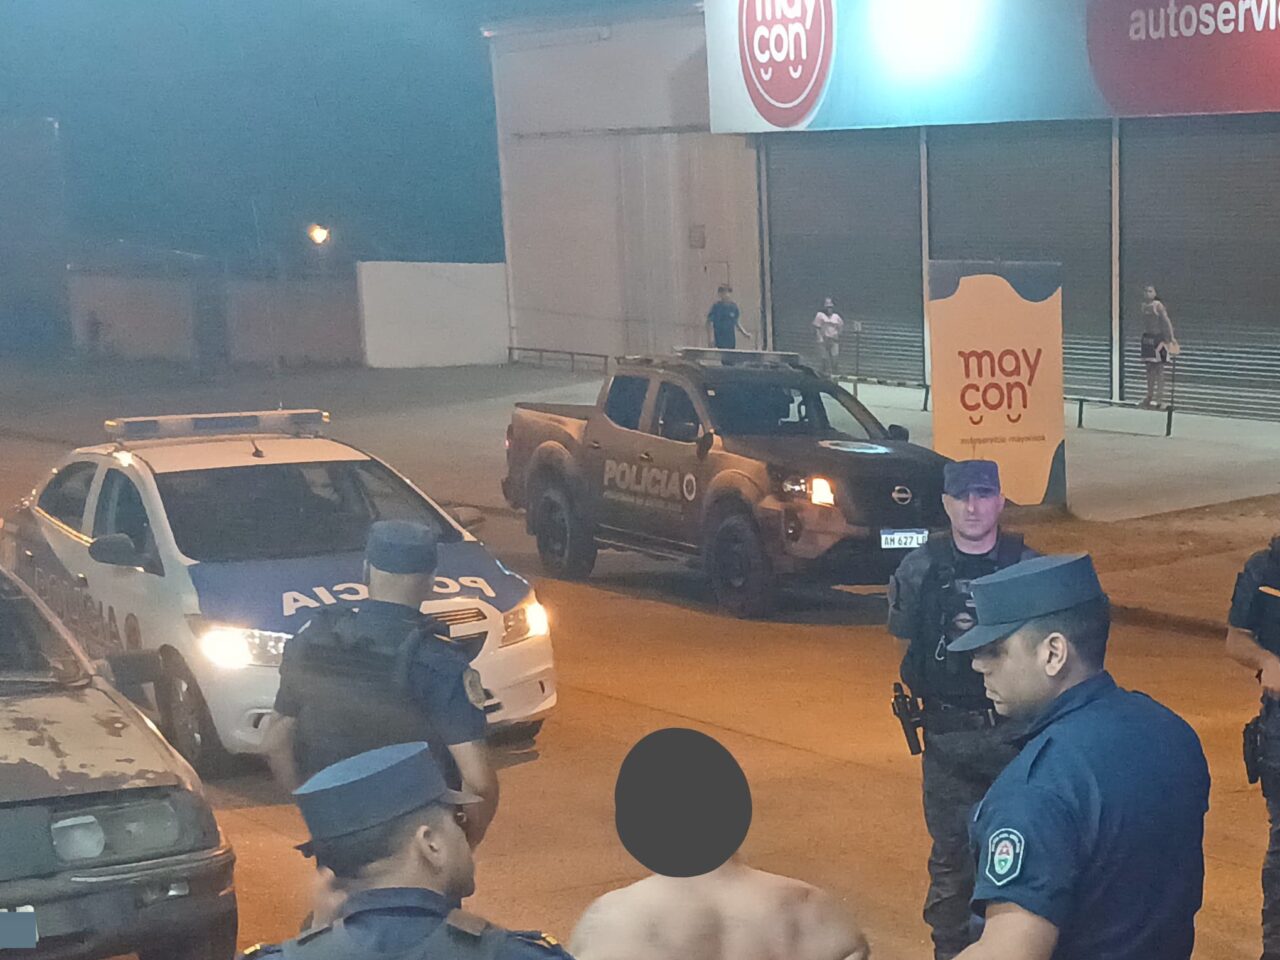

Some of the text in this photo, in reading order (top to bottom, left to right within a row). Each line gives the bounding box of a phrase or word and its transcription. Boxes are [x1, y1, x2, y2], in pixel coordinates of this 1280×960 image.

[753, 22, 807, 64] con
[957, 348, 1042, 386] may
[960, 381, 1028, 412] con
[603, 459, 681, 499] POLICIA
